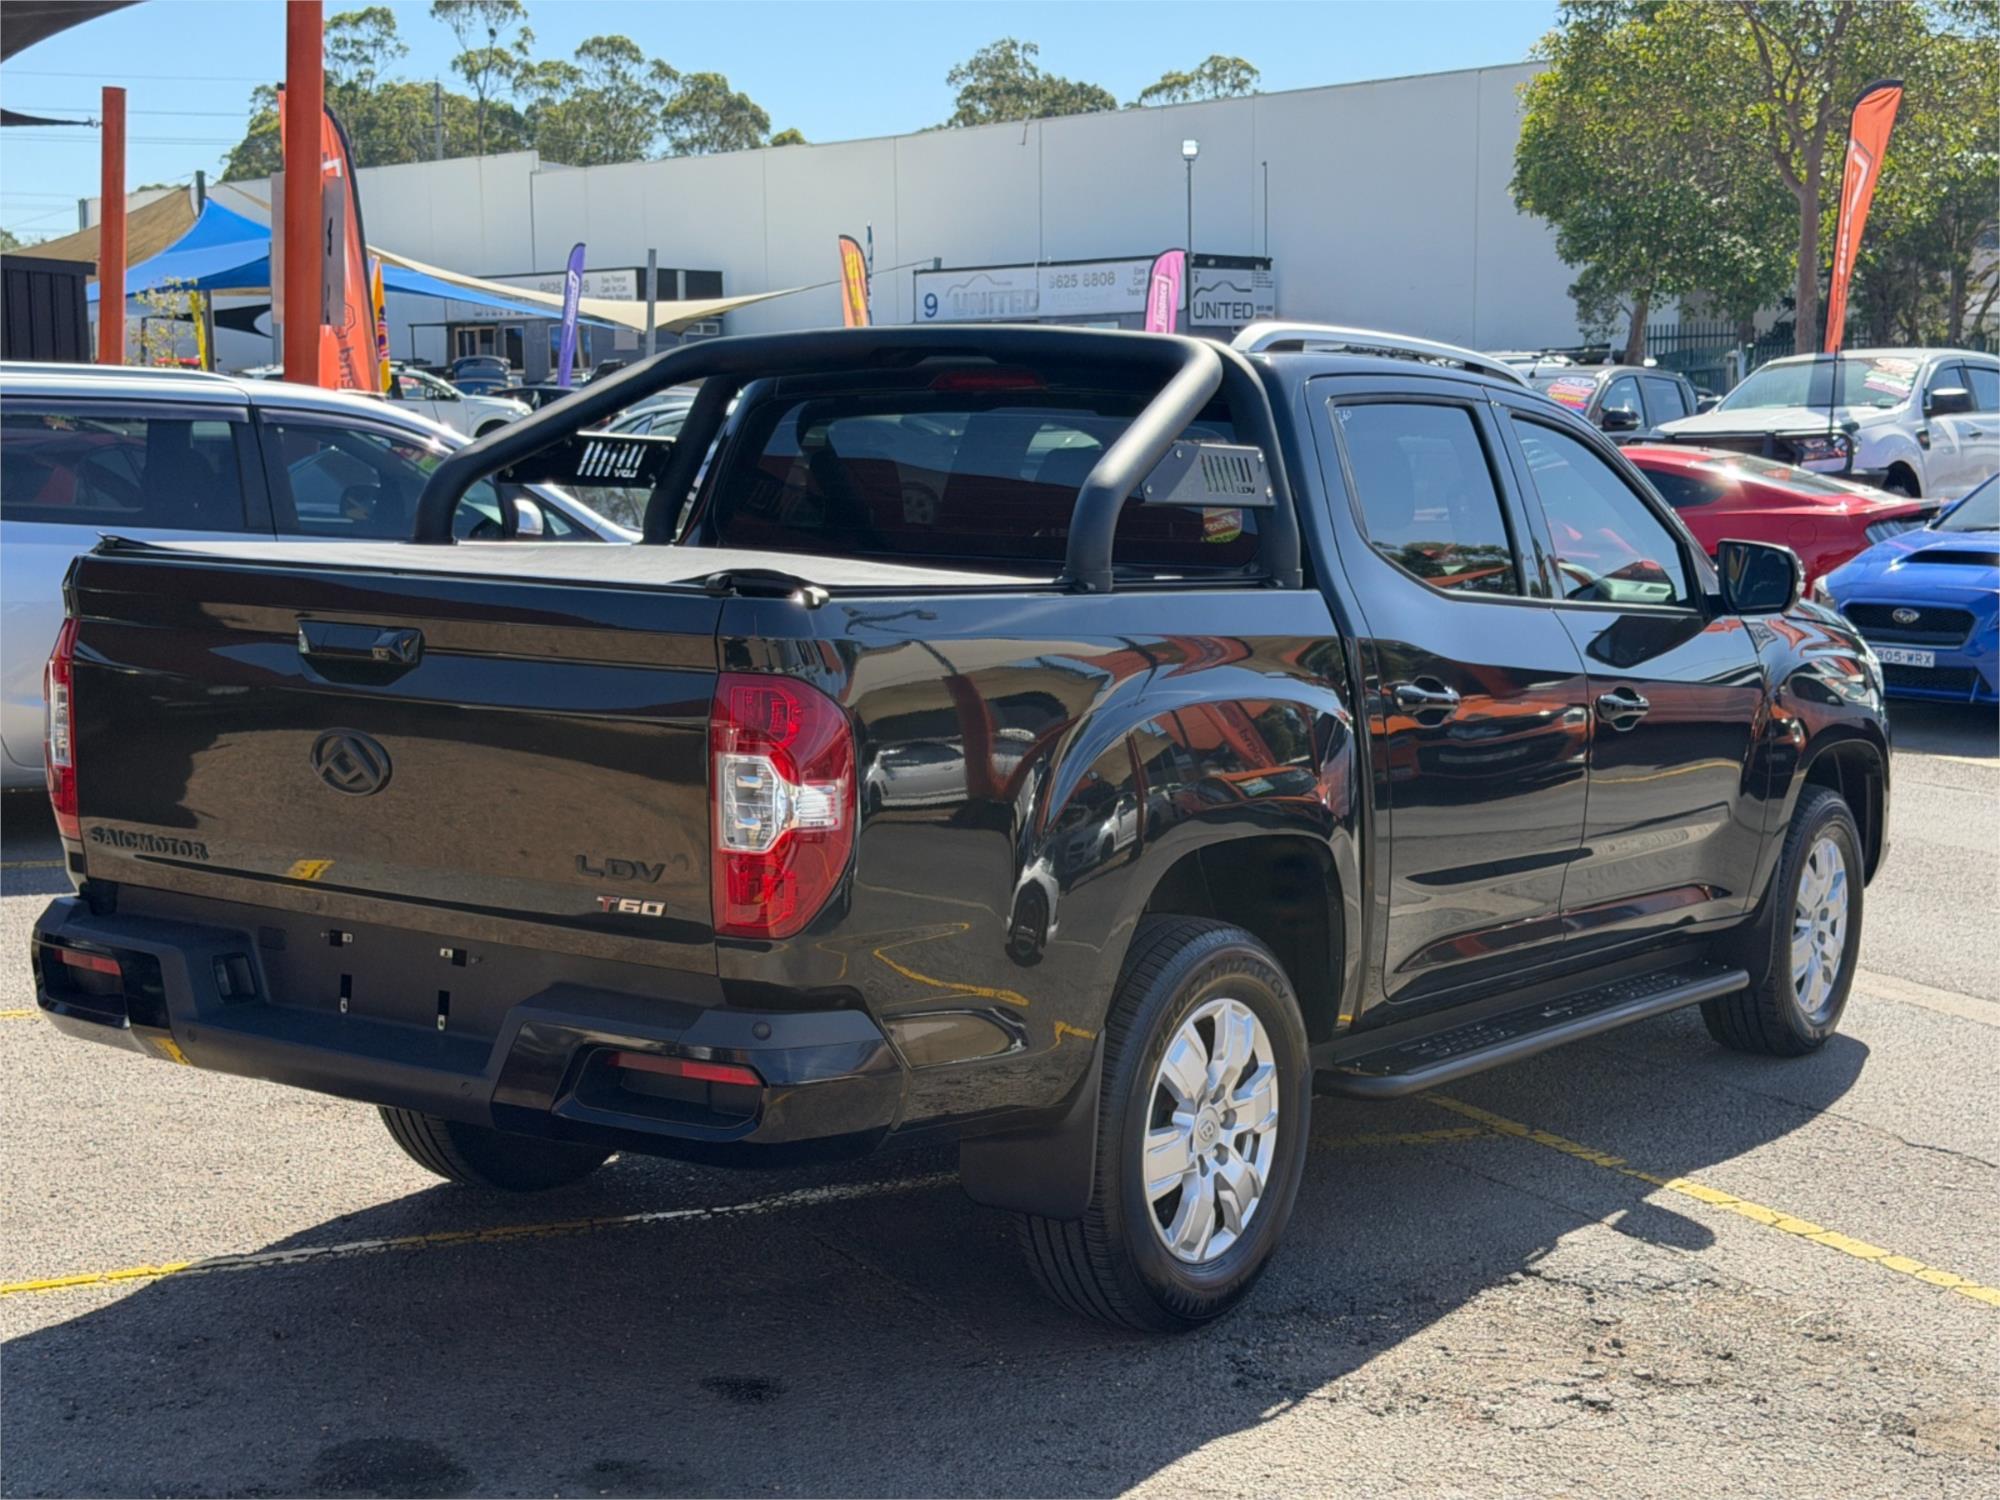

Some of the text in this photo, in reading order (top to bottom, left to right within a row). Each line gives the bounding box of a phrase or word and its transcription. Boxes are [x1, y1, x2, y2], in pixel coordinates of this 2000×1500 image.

[923, 292, 939, 319] 9
[1193, 301, 1255, 320] UNITED
[90, 826, 208, 861] SAICMOTOR
[576, 854, 666, 883] LDV
[596, 895, 667, 917] T60
